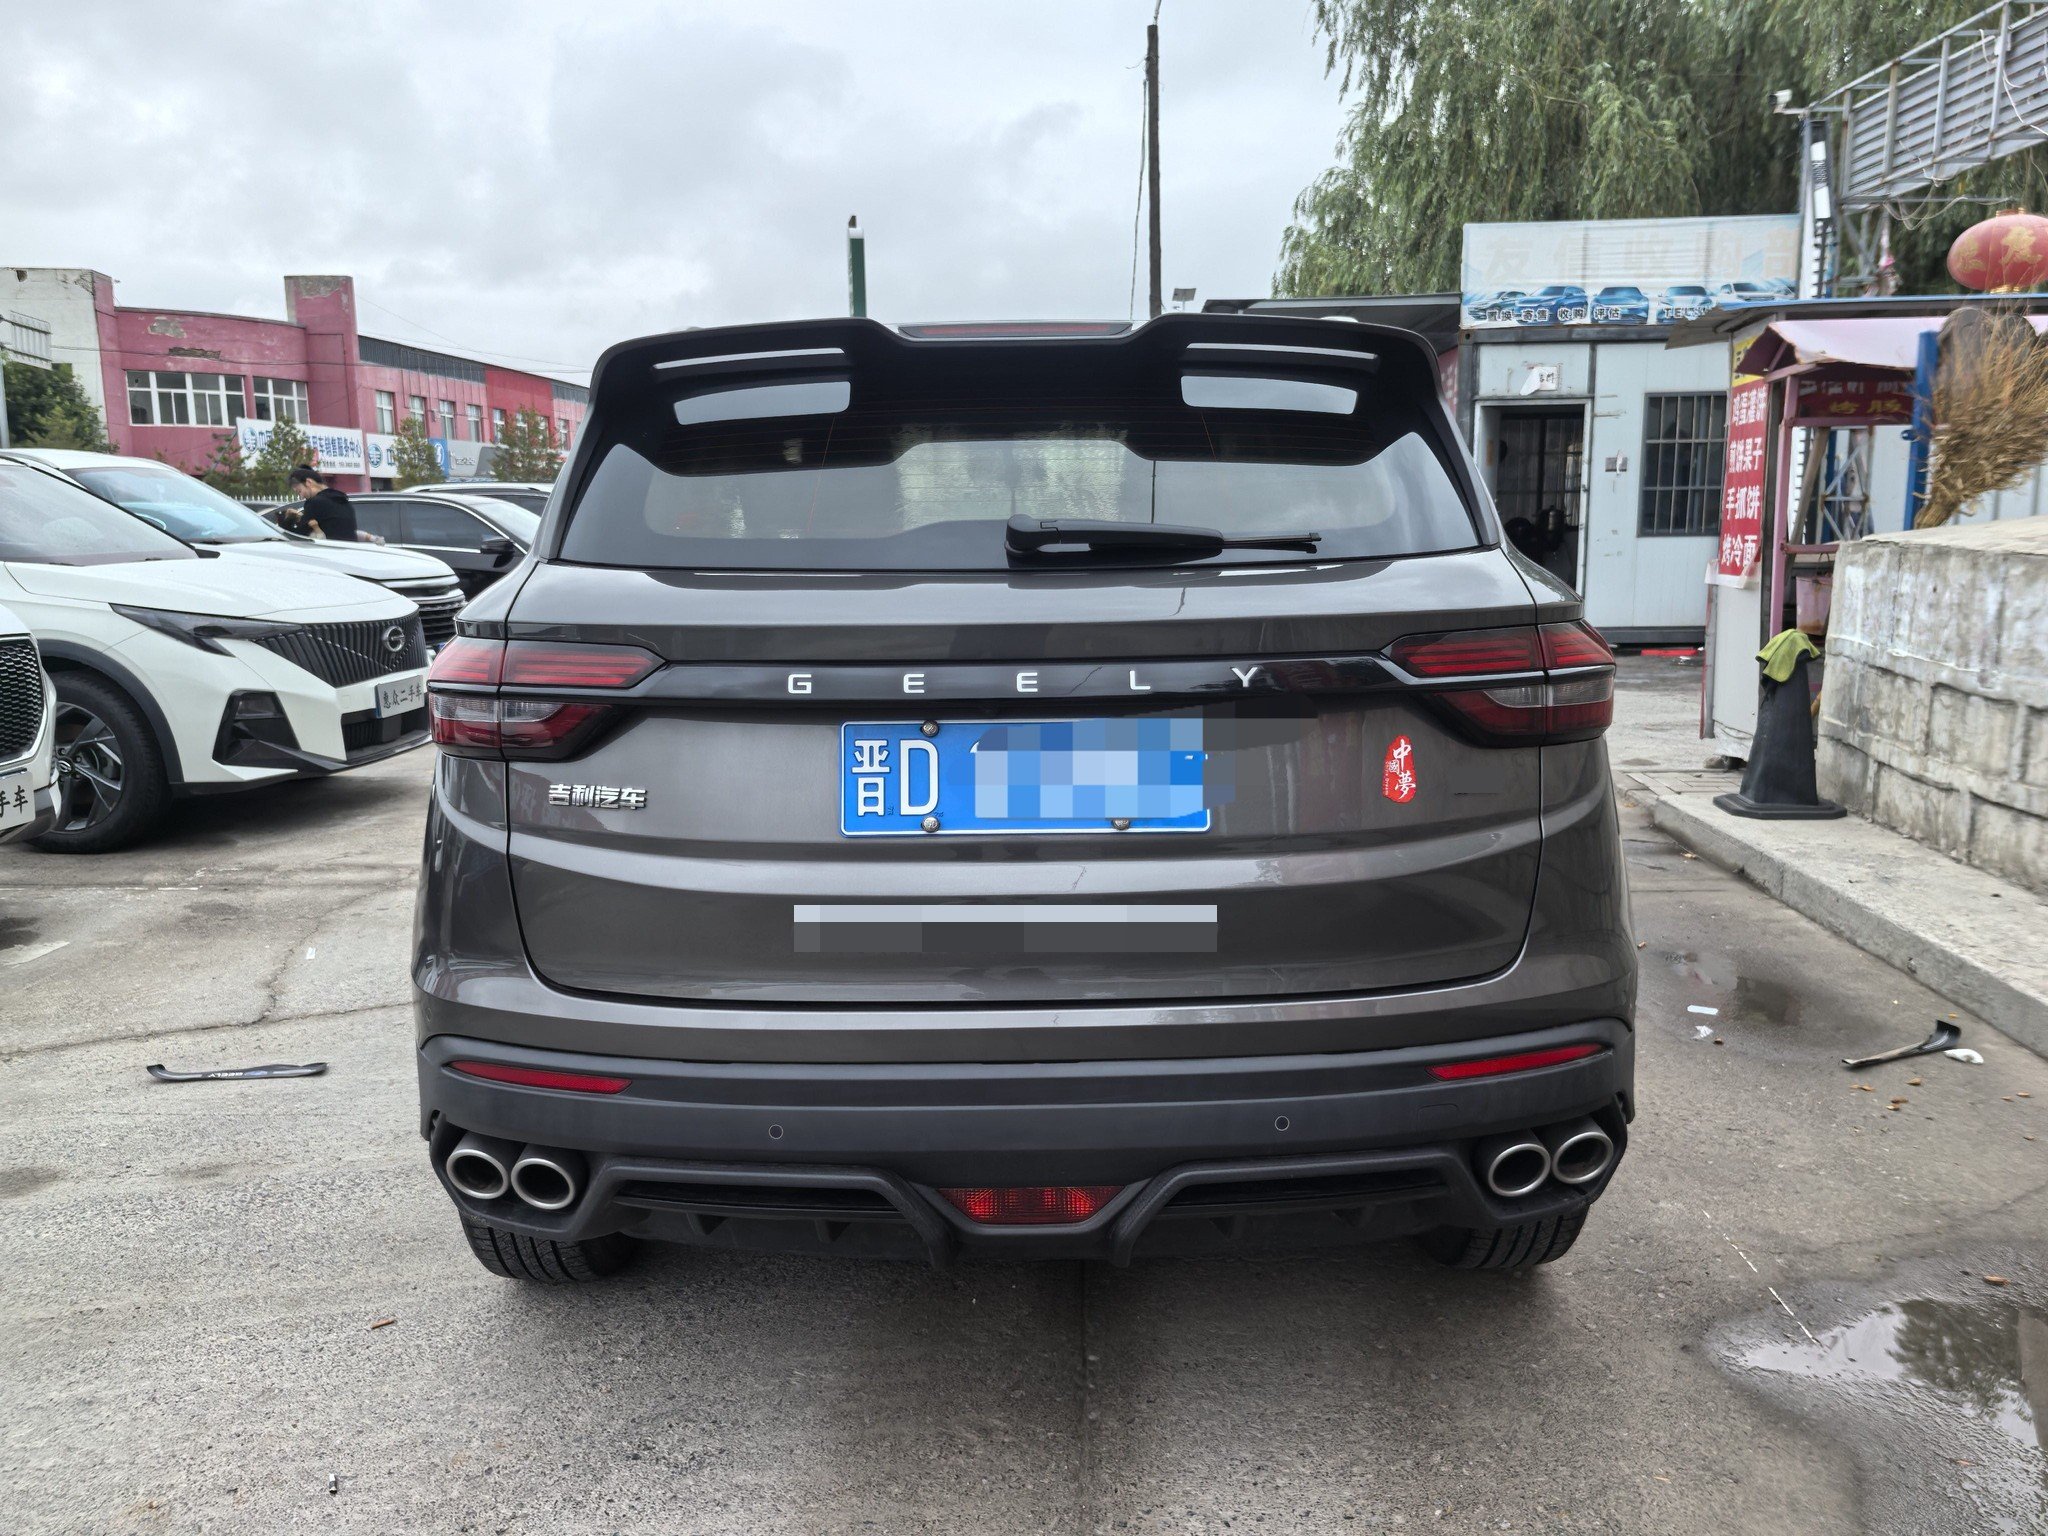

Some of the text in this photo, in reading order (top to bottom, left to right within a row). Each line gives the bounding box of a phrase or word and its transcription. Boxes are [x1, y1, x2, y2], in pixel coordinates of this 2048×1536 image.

[1558, 308, 1584, 320] 收购
[1594, 307, 1621, 319] 评估
[1732, 385, 1769, 427] 鸡蛋灌饼
[1729, 437, 1763, 473] 煎饼果子
[1726, 485, 1761, 520] 手抓饼
[1722, 533, 1757, 567] 烤冷面
[383, 683, 422, 709] 惠众二手车
[787, 666, 1258, 695] GEELY
[548, 783, 647, 810] 吉利汽车
